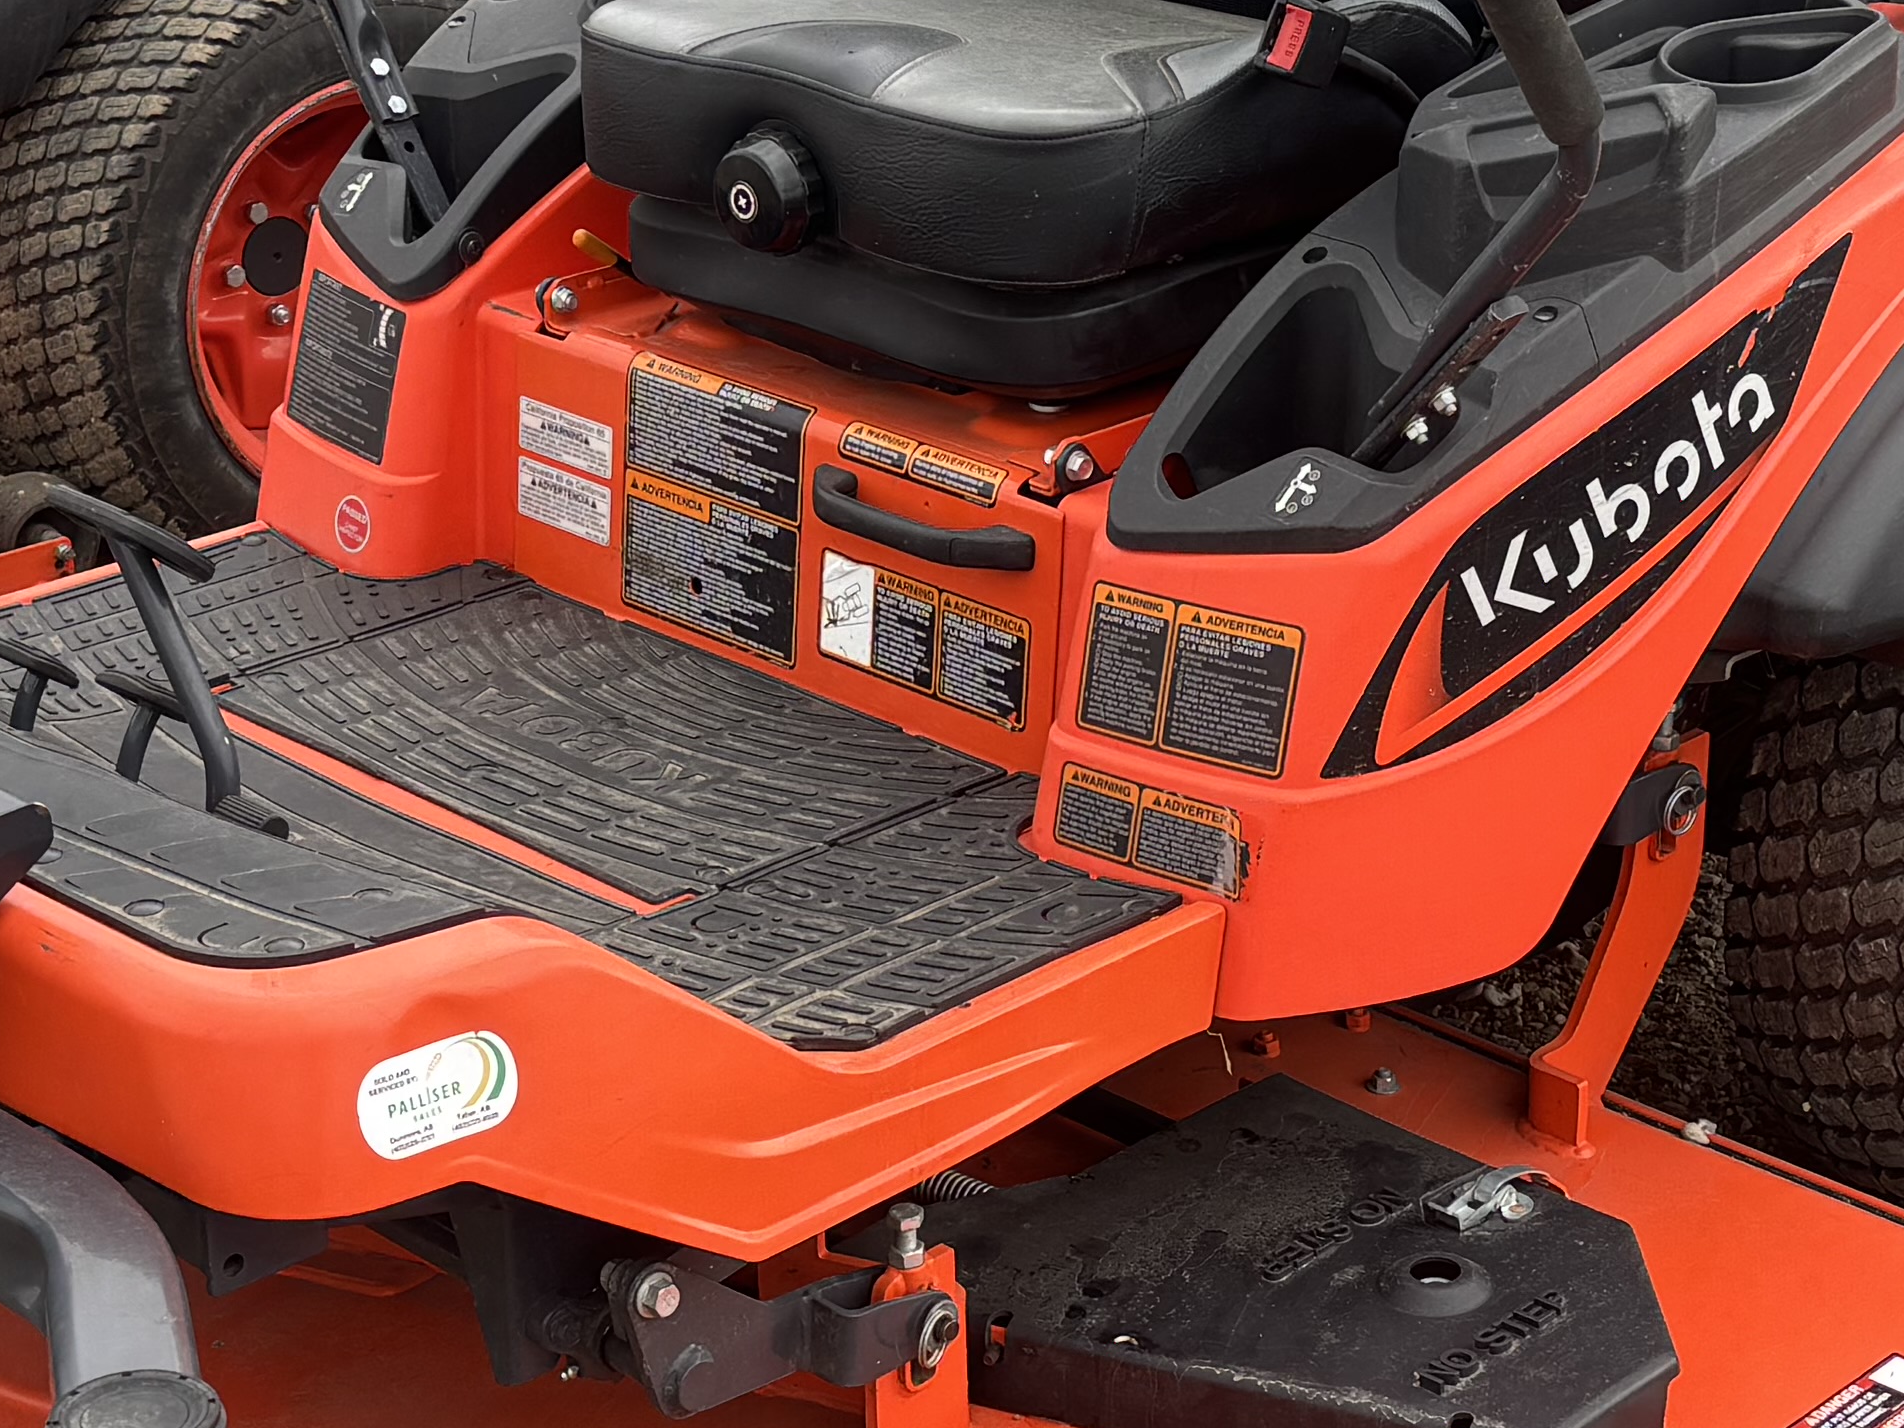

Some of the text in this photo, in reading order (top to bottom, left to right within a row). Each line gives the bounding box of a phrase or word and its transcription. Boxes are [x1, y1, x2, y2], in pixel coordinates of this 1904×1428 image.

[658, 362, 702, 384] WARNING
[866, 427, 911, 450] WARNING
[931, 449, 999, 480] ADVERTENCIA
[640, 482, 705, 514] ADVERTENCIA
[1459, 372, 1776, 628] Kubota
[885, 575, 935, 603] WARNING
[1117, 592, 1164, 613] WARNING
[953, 599, 1025, 635] ADVERTENCIA
[1205, 615, 1286, 641] ADVERTENCIA
[1179, 632, 1265, 659] PERSONALES GRAVES
[1180, 624, 1272, 652] PARA EVITAR LESIONES
[1197, 645, 1230, 659] MUERTE
[1079, 772, 1132, 798] WARNING
[387, 1080, 462, 1119] PALLISER
[1413, 1289, 1569, 1396] NO STEP
[1812, 1383, 1866, 1423] DANGER
